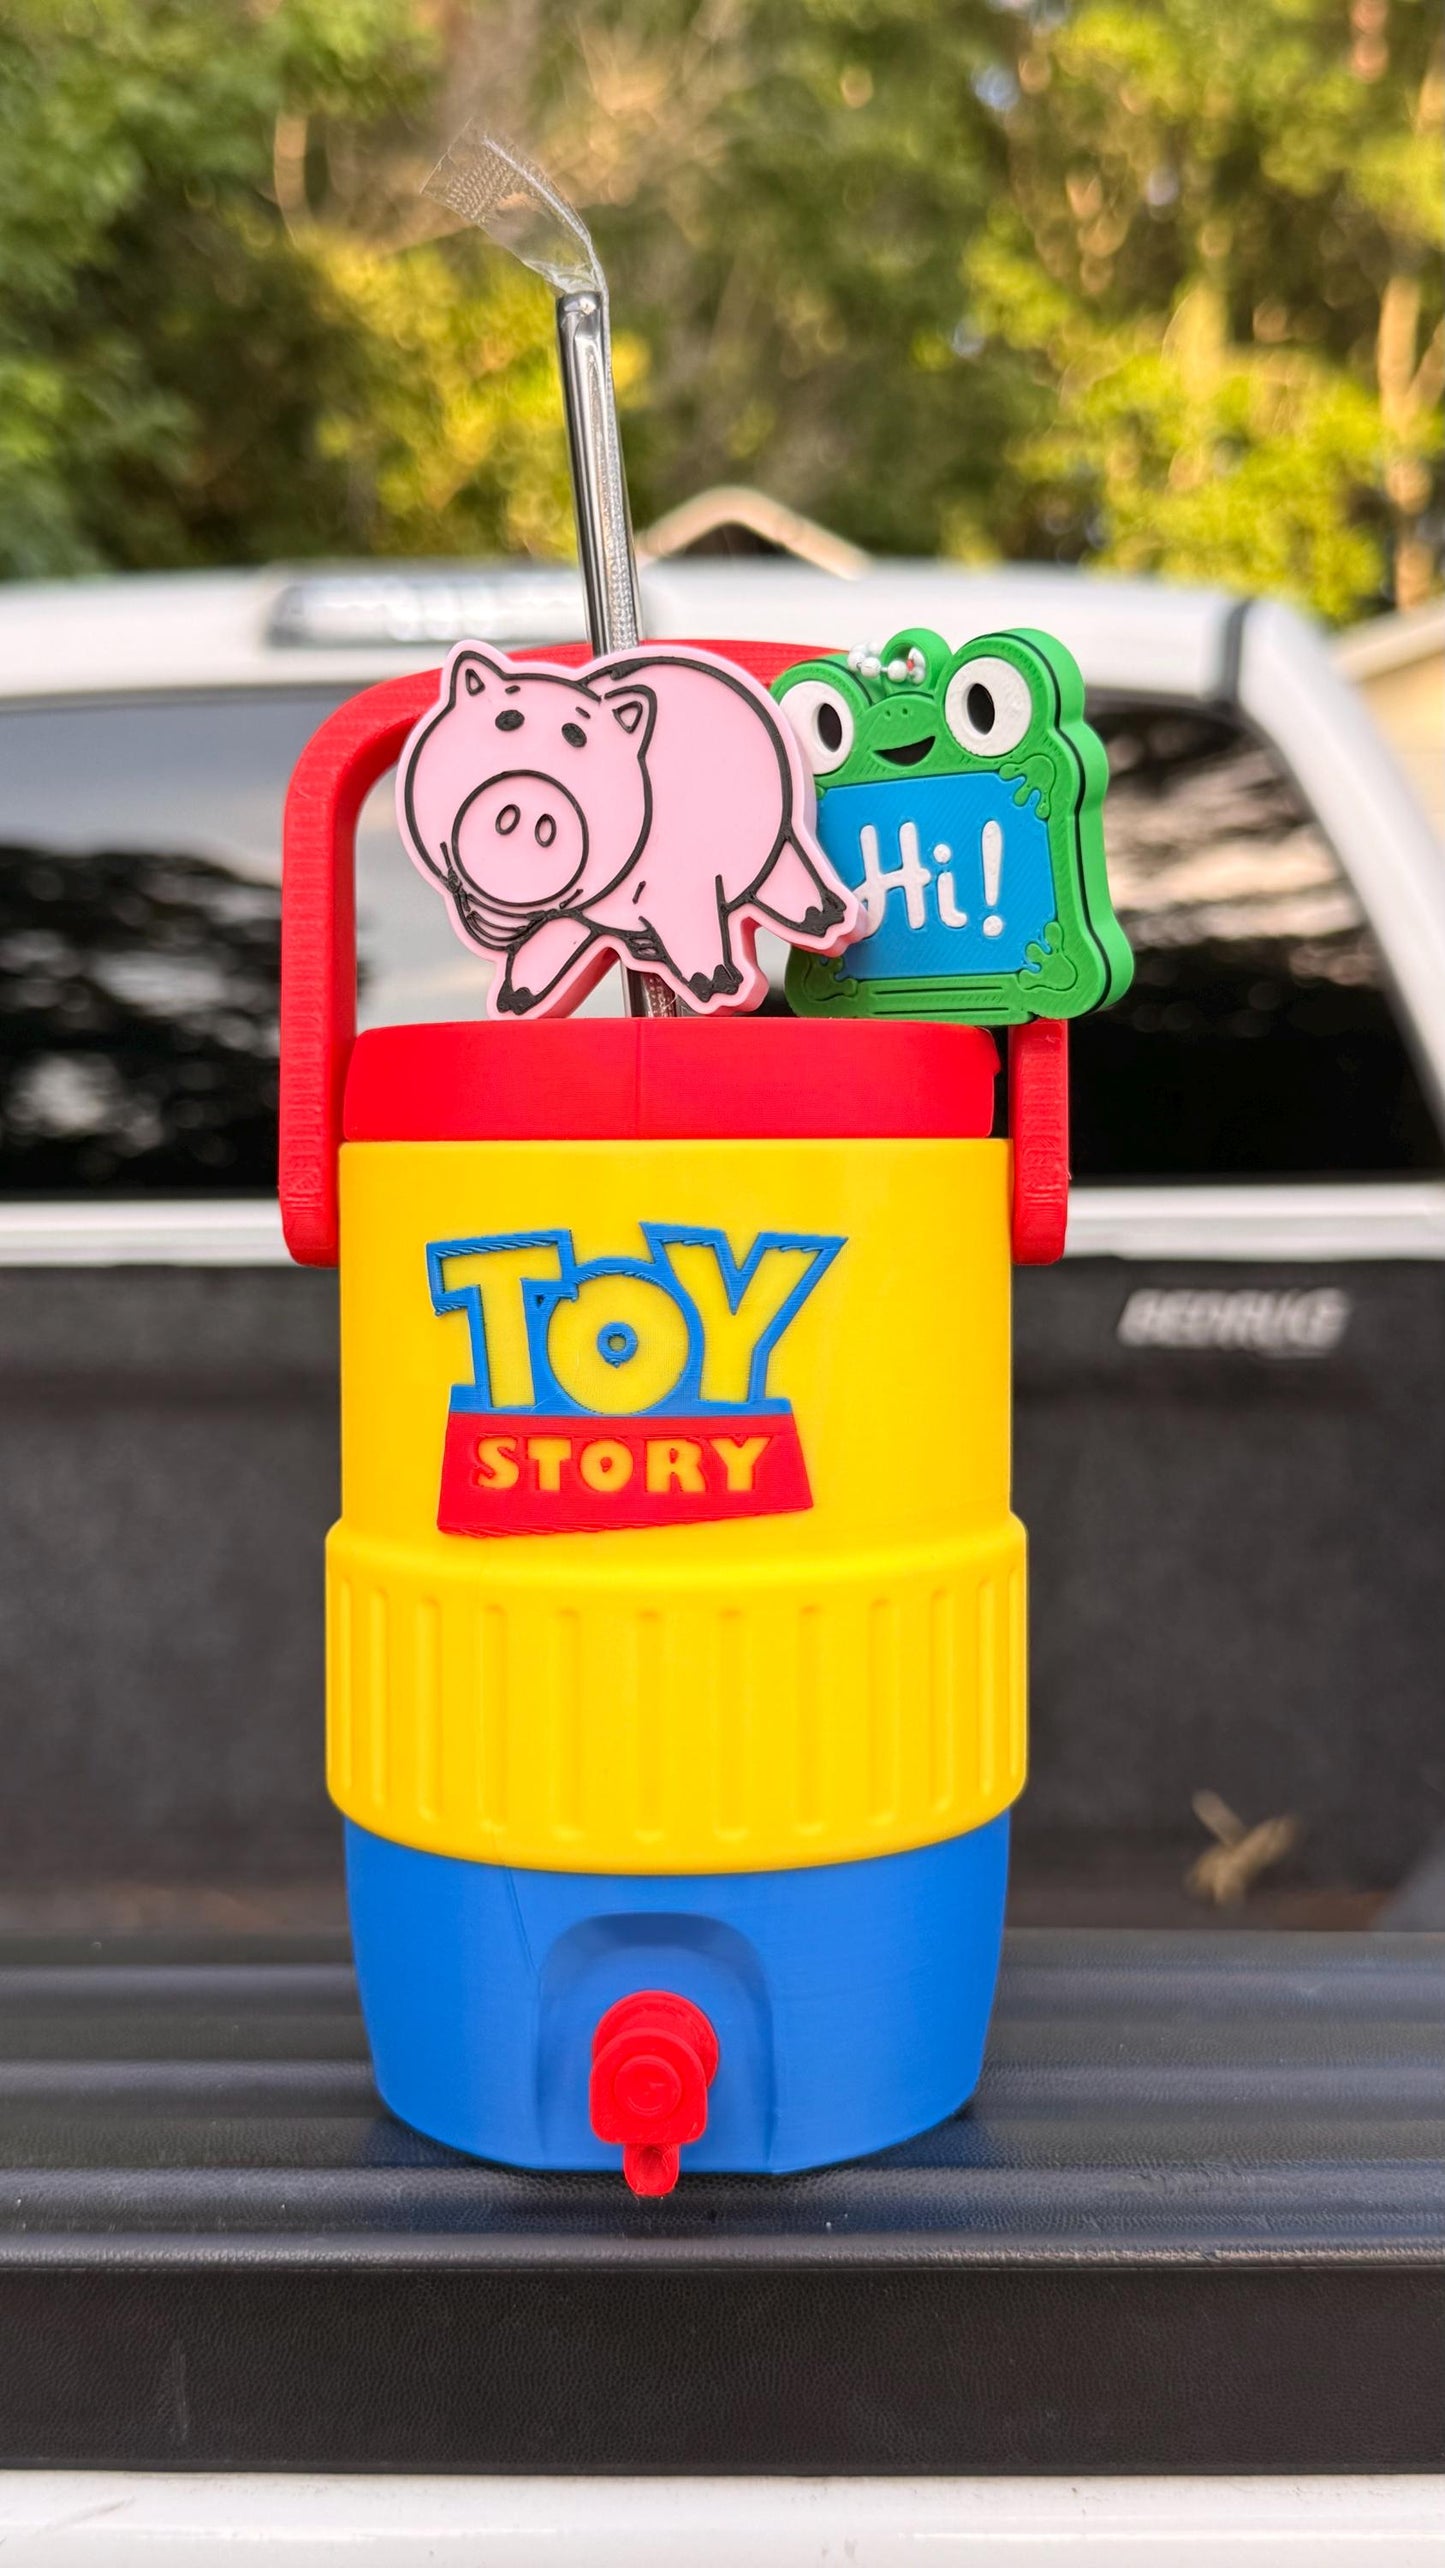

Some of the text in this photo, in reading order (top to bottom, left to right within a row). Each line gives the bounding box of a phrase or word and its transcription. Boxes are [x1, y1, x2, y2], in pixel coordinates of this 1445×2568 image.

[853, 820, 1003, 938] Hi!
[427, 1222, 848, 1415] TOY
[476, 1435, 773, 1493] STORY
